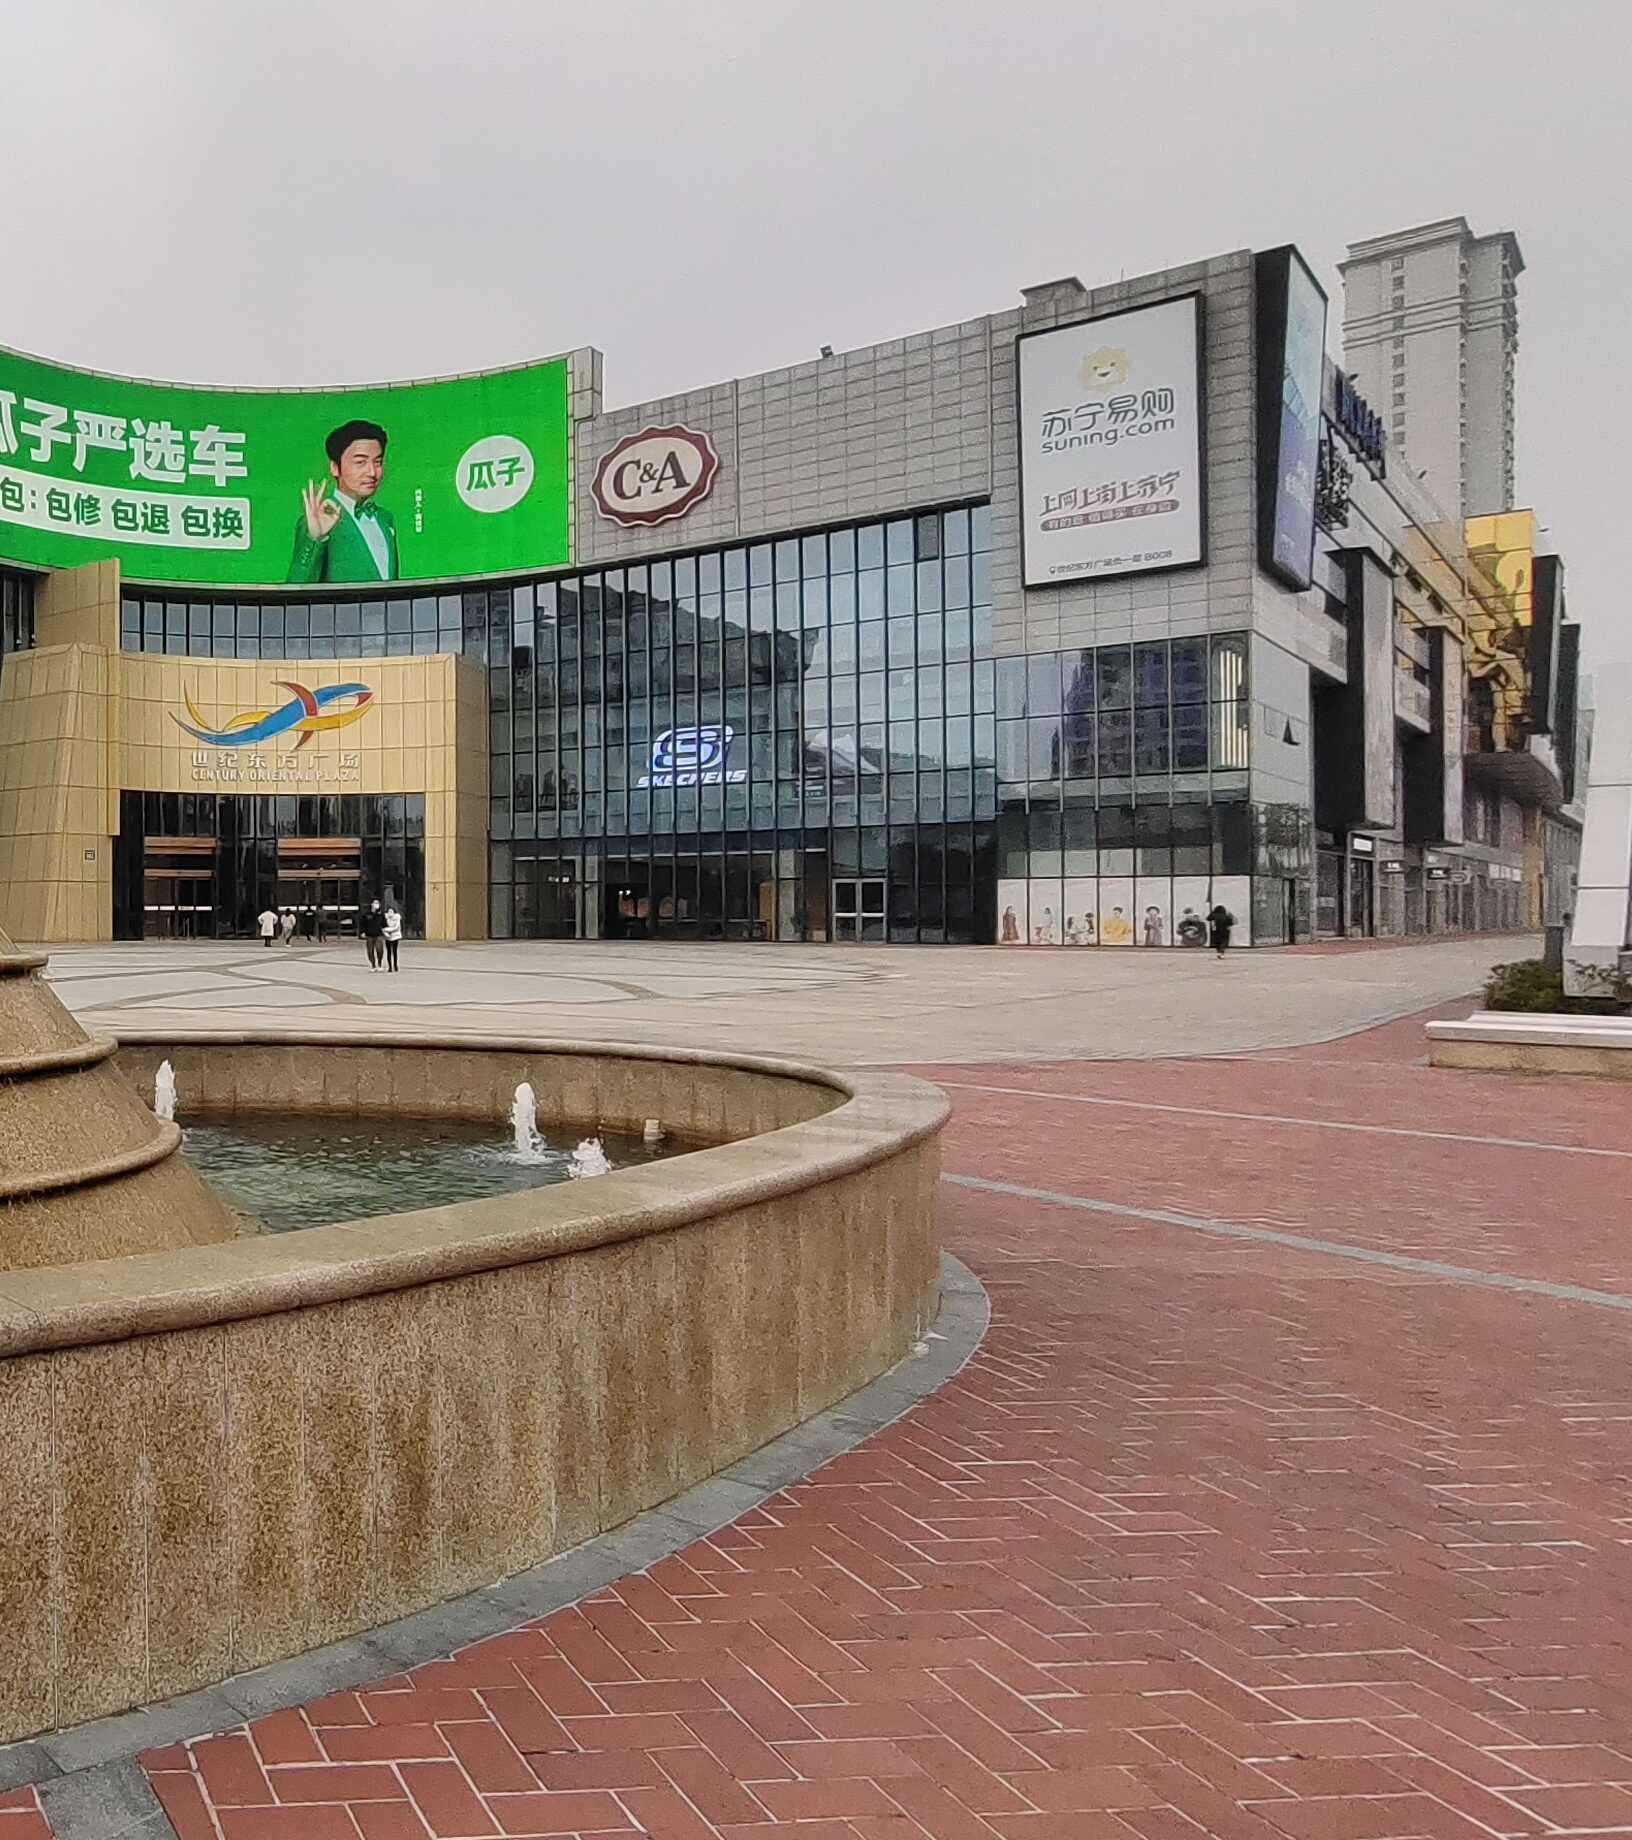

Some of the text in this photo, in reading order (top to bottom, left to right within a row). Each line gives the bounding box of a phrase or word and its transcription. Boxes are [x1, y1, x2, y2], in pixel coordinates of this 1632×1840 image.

[1041, 387, 1175, 438] 苏宁易购
[1041, 418, 1175, 454] suning.com
[465, 456, 527, 492] 瓜子
[613, 450, 691, 500] C&A
[1039, 470, 1181, 517] 上网上街上苏宁
[111, 498, 170, 535] 包退
[181, 505, 244, 539] 包换
[191, 751, 360, 769] 世纪东方广场
[191, 768, 360, 783] CENTURY ORIENTAL PLAZA
[636, 769, 748, 788] SKECHERS
